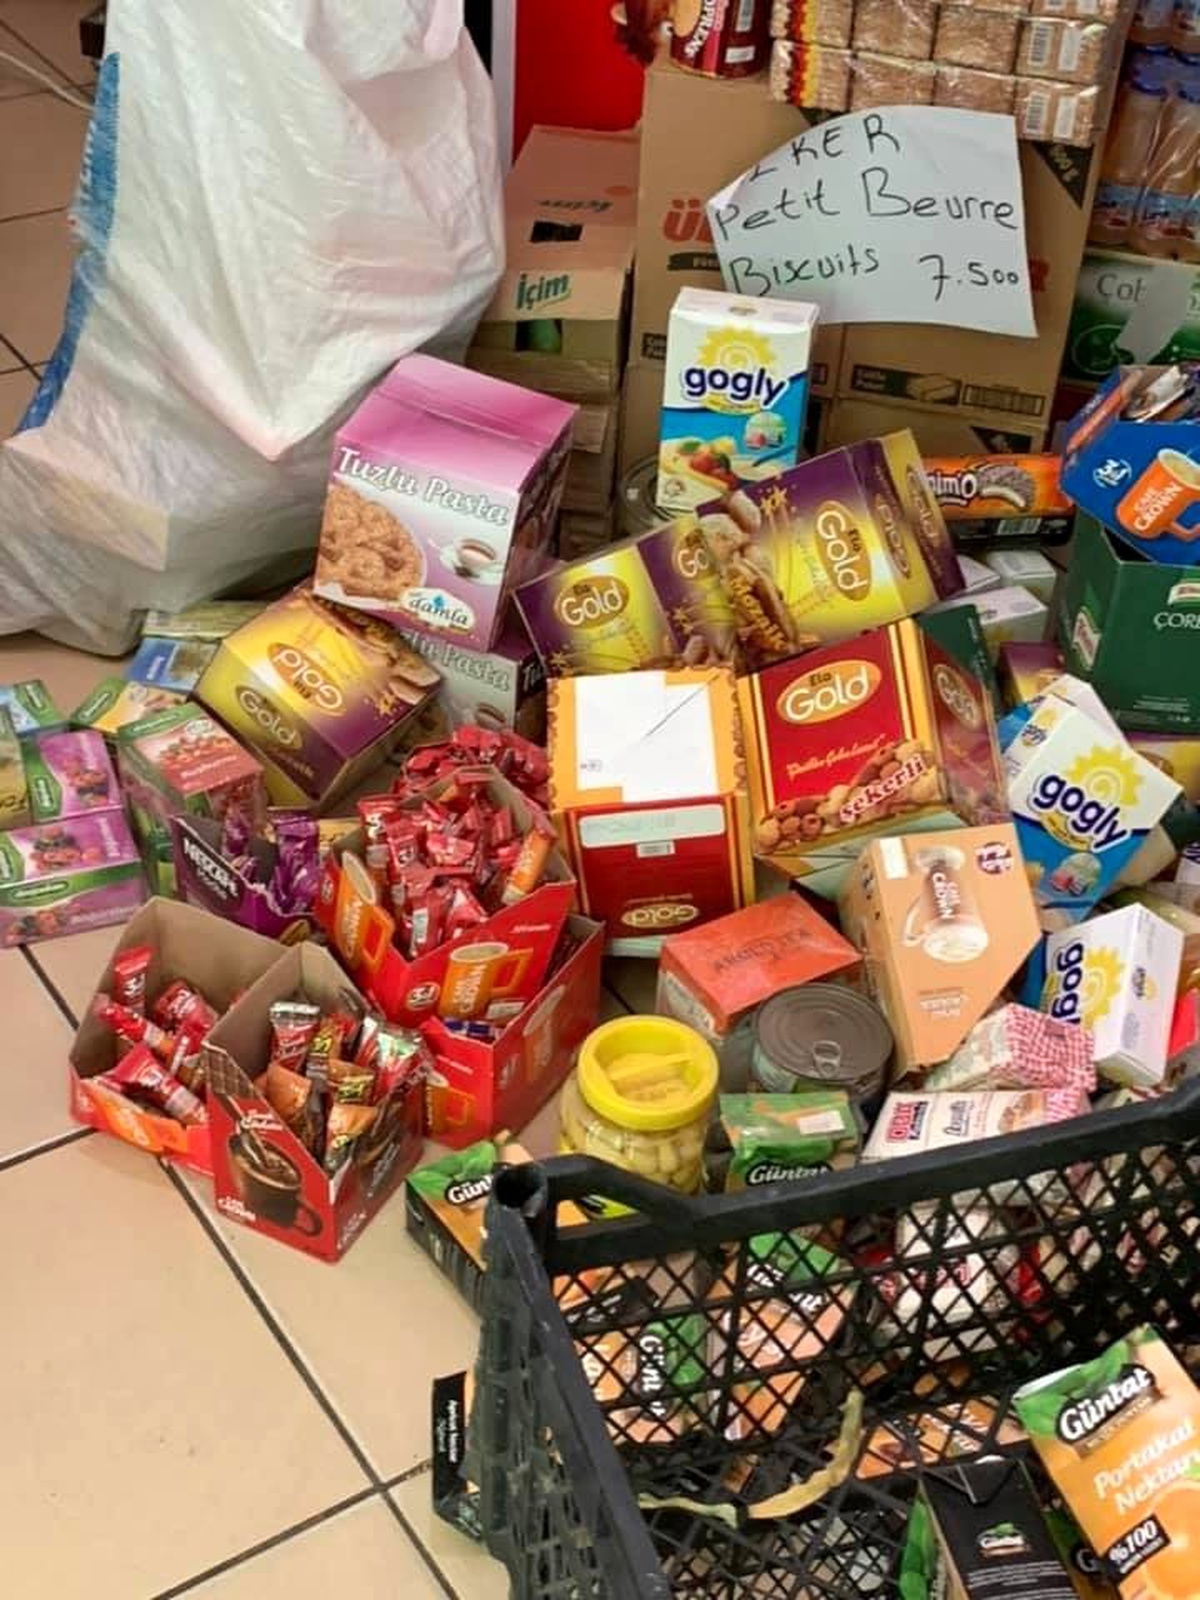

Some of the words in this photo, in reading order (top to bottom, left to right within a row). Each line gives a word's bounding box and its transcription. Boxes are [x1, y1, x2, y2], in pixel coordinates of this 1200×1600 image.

[715, 178, 841, 241] Petit
[861, 166, 1018, 229] Beurre
[729, 244, 879, 297] Biscuits
[918, 253, 1020, 302] 7.500
[684, 367, 786, 407] gogly
[337, 446, 418, 496] Tuzlu
[423, 474, 510, 526] Pasta
[1134, 482, 1185, 531] CROWN
[816, 510, 868, 590] Gold
[409, 595, 469, 626] damla
[561, 579, 623, 626] Gold
[273, 648, 343, 710] Gold
[442, 643, 510, 692] Pasta
[786, 665, 869, 721] Gold
[240, 690, 297, 745] Gold
[1033, 774, 1128, 849] gogly
[1060, 1367, 1151, 1440] Güntat
[1093, 1417, 1194, 1499] Portakal
[1108, 1520, 1158, 1564] %100
